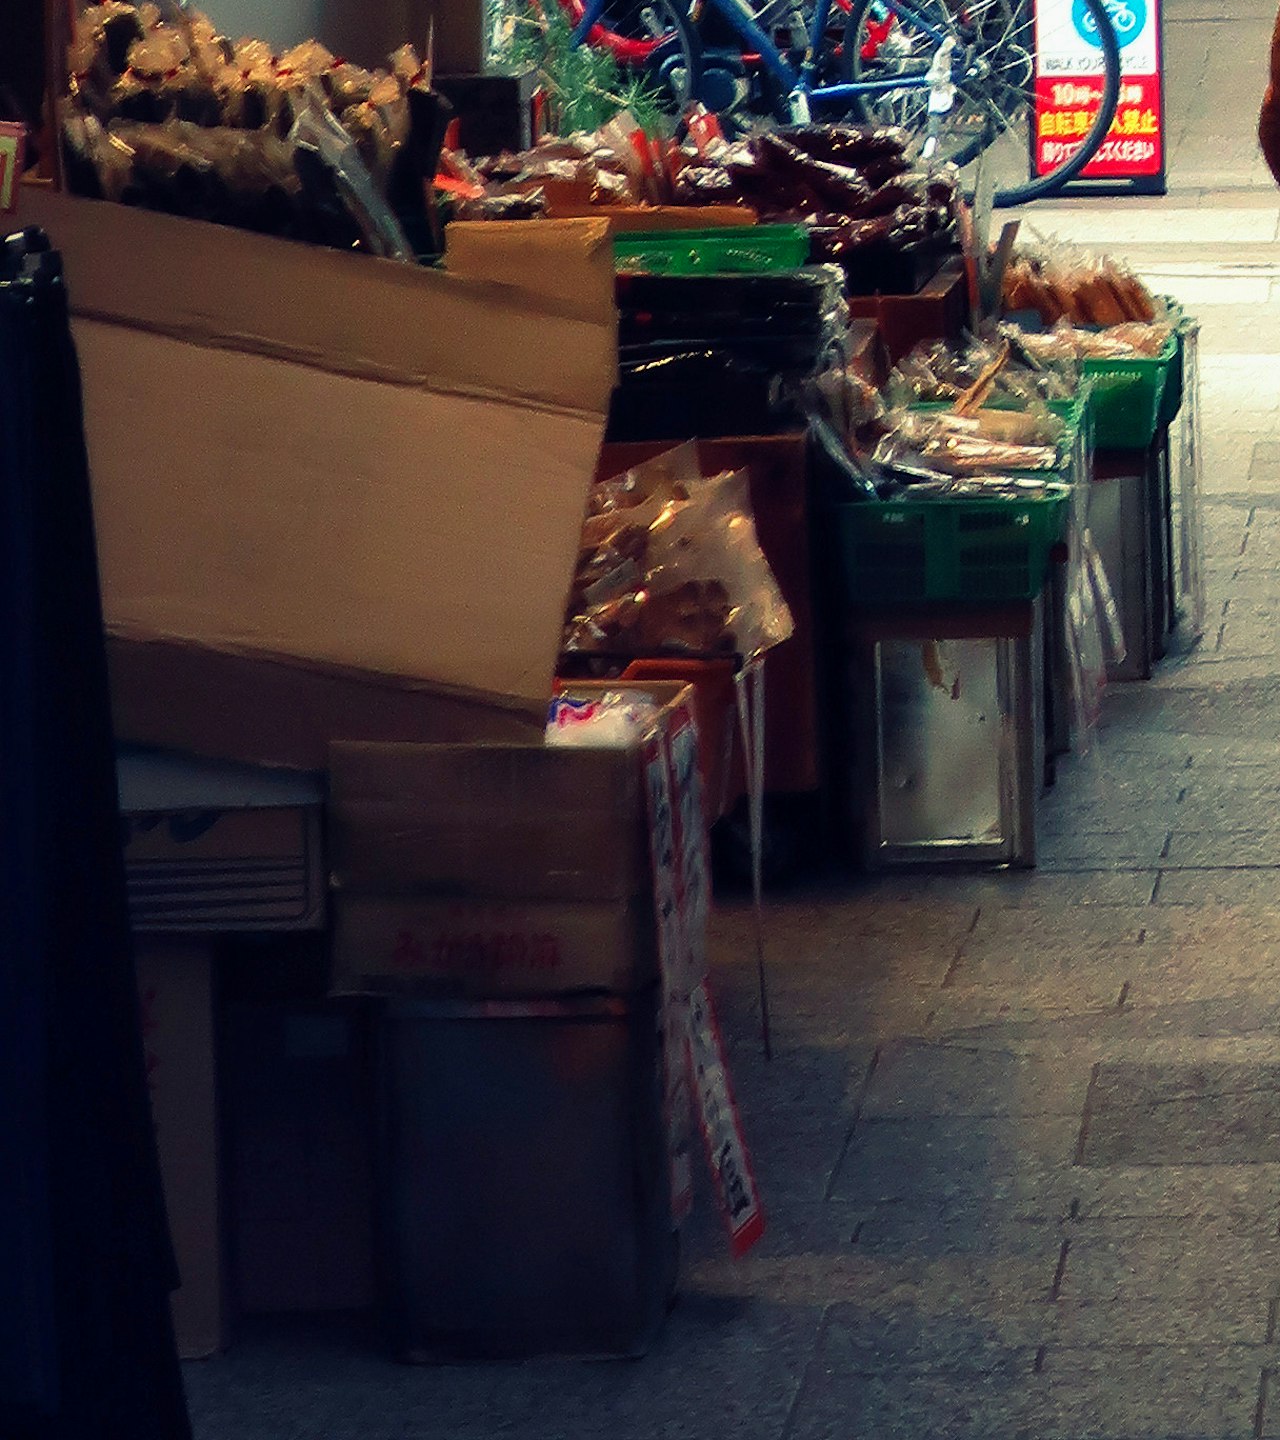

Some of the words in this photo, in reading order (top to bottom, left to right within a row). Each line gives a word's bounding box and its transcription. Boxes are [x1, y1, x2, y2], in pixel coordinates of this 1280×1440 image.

[1038, 109, 1158, 136] 自転車入禁止
